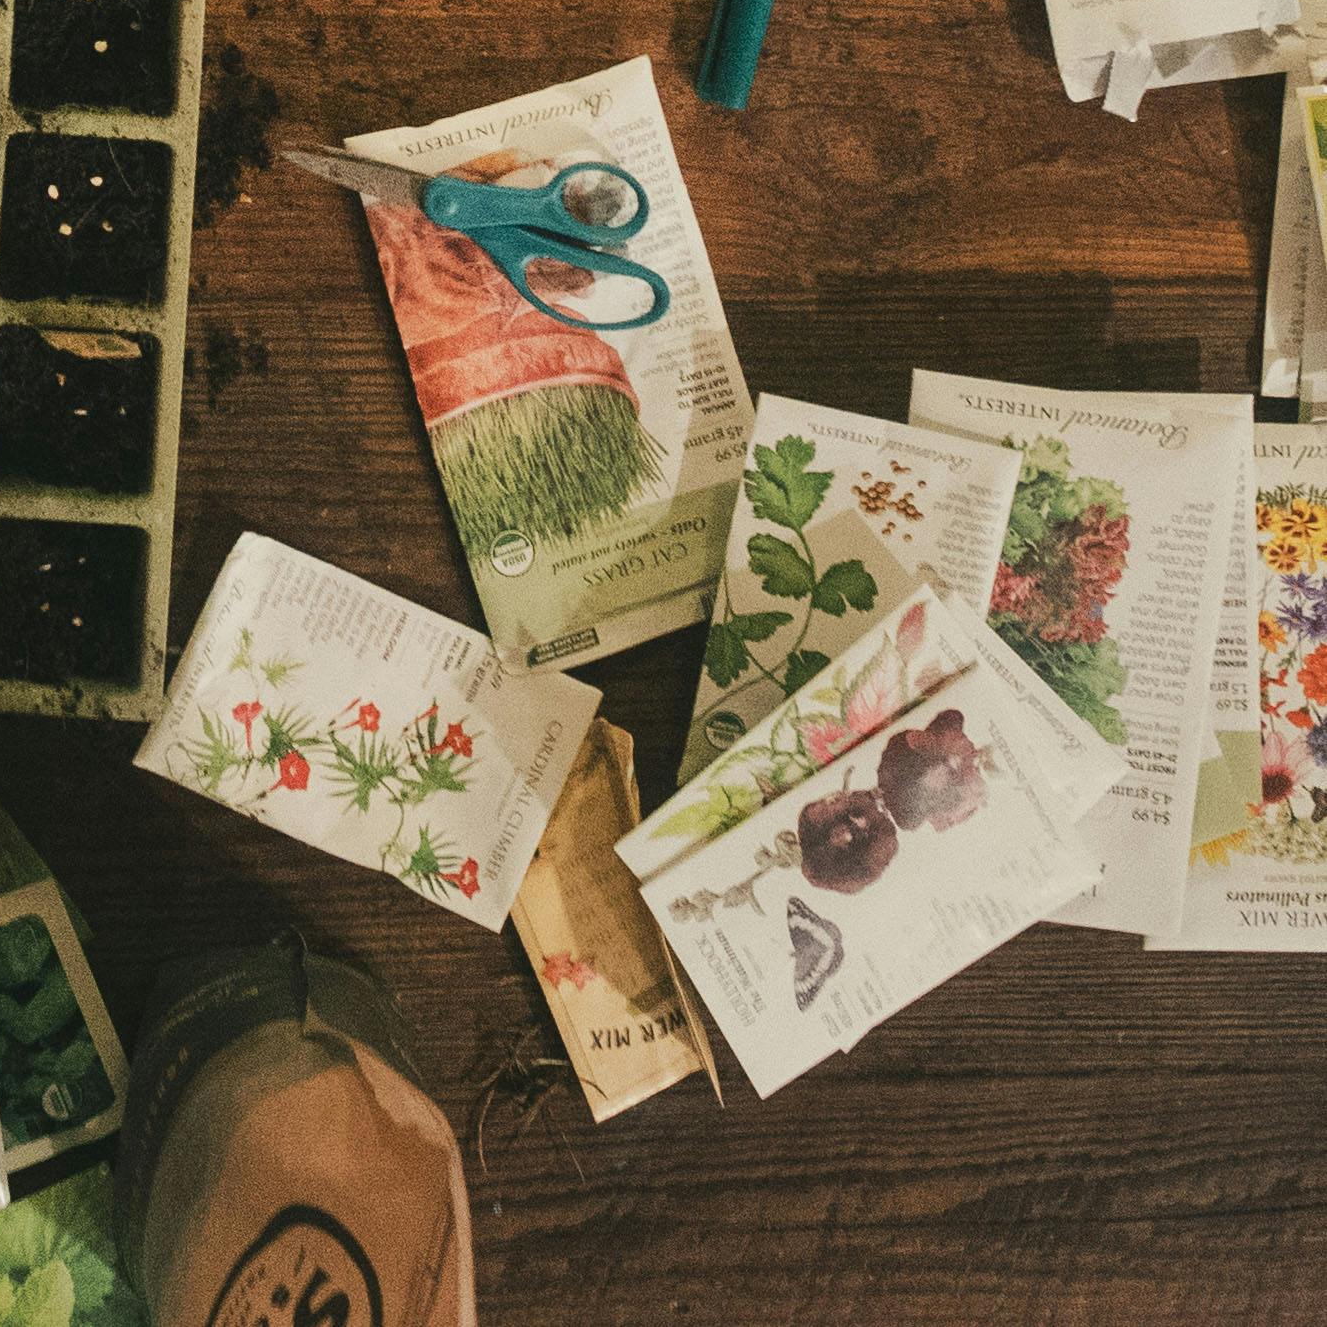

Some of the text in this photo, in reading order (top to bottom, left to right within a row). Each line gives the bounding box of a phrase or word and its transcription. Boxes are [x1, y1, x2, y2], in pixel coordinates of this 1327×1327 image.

[495, 86, 615, 144] Botanical
[700, 399, 736, 415] ANNUAL
[726, 423, 744, 439] 45
[1057, 408, 1190, 452] Botanical
[669, 515, 708, 538] Oats
[589, 544, 611, 561] not
[612, 530, 657, 554] variety
[499, 551, 527, 568] USDA
[549, 551, 587, 575] stated
[581, 539, 688, 588] CAT GRASS
[511, 717, 566, 811] CARDINAL
[1131, 806, 1171, 825] $4.99
[480, 806, 525, 883] CLIMBER
[1225, 890, 1309, 908] Pollinators
[1237, 910, 1277, 936] MIX
[691, 931, 757, 1028] HOLLYHOCK
[586, 1025, 631, 1052] MIX
